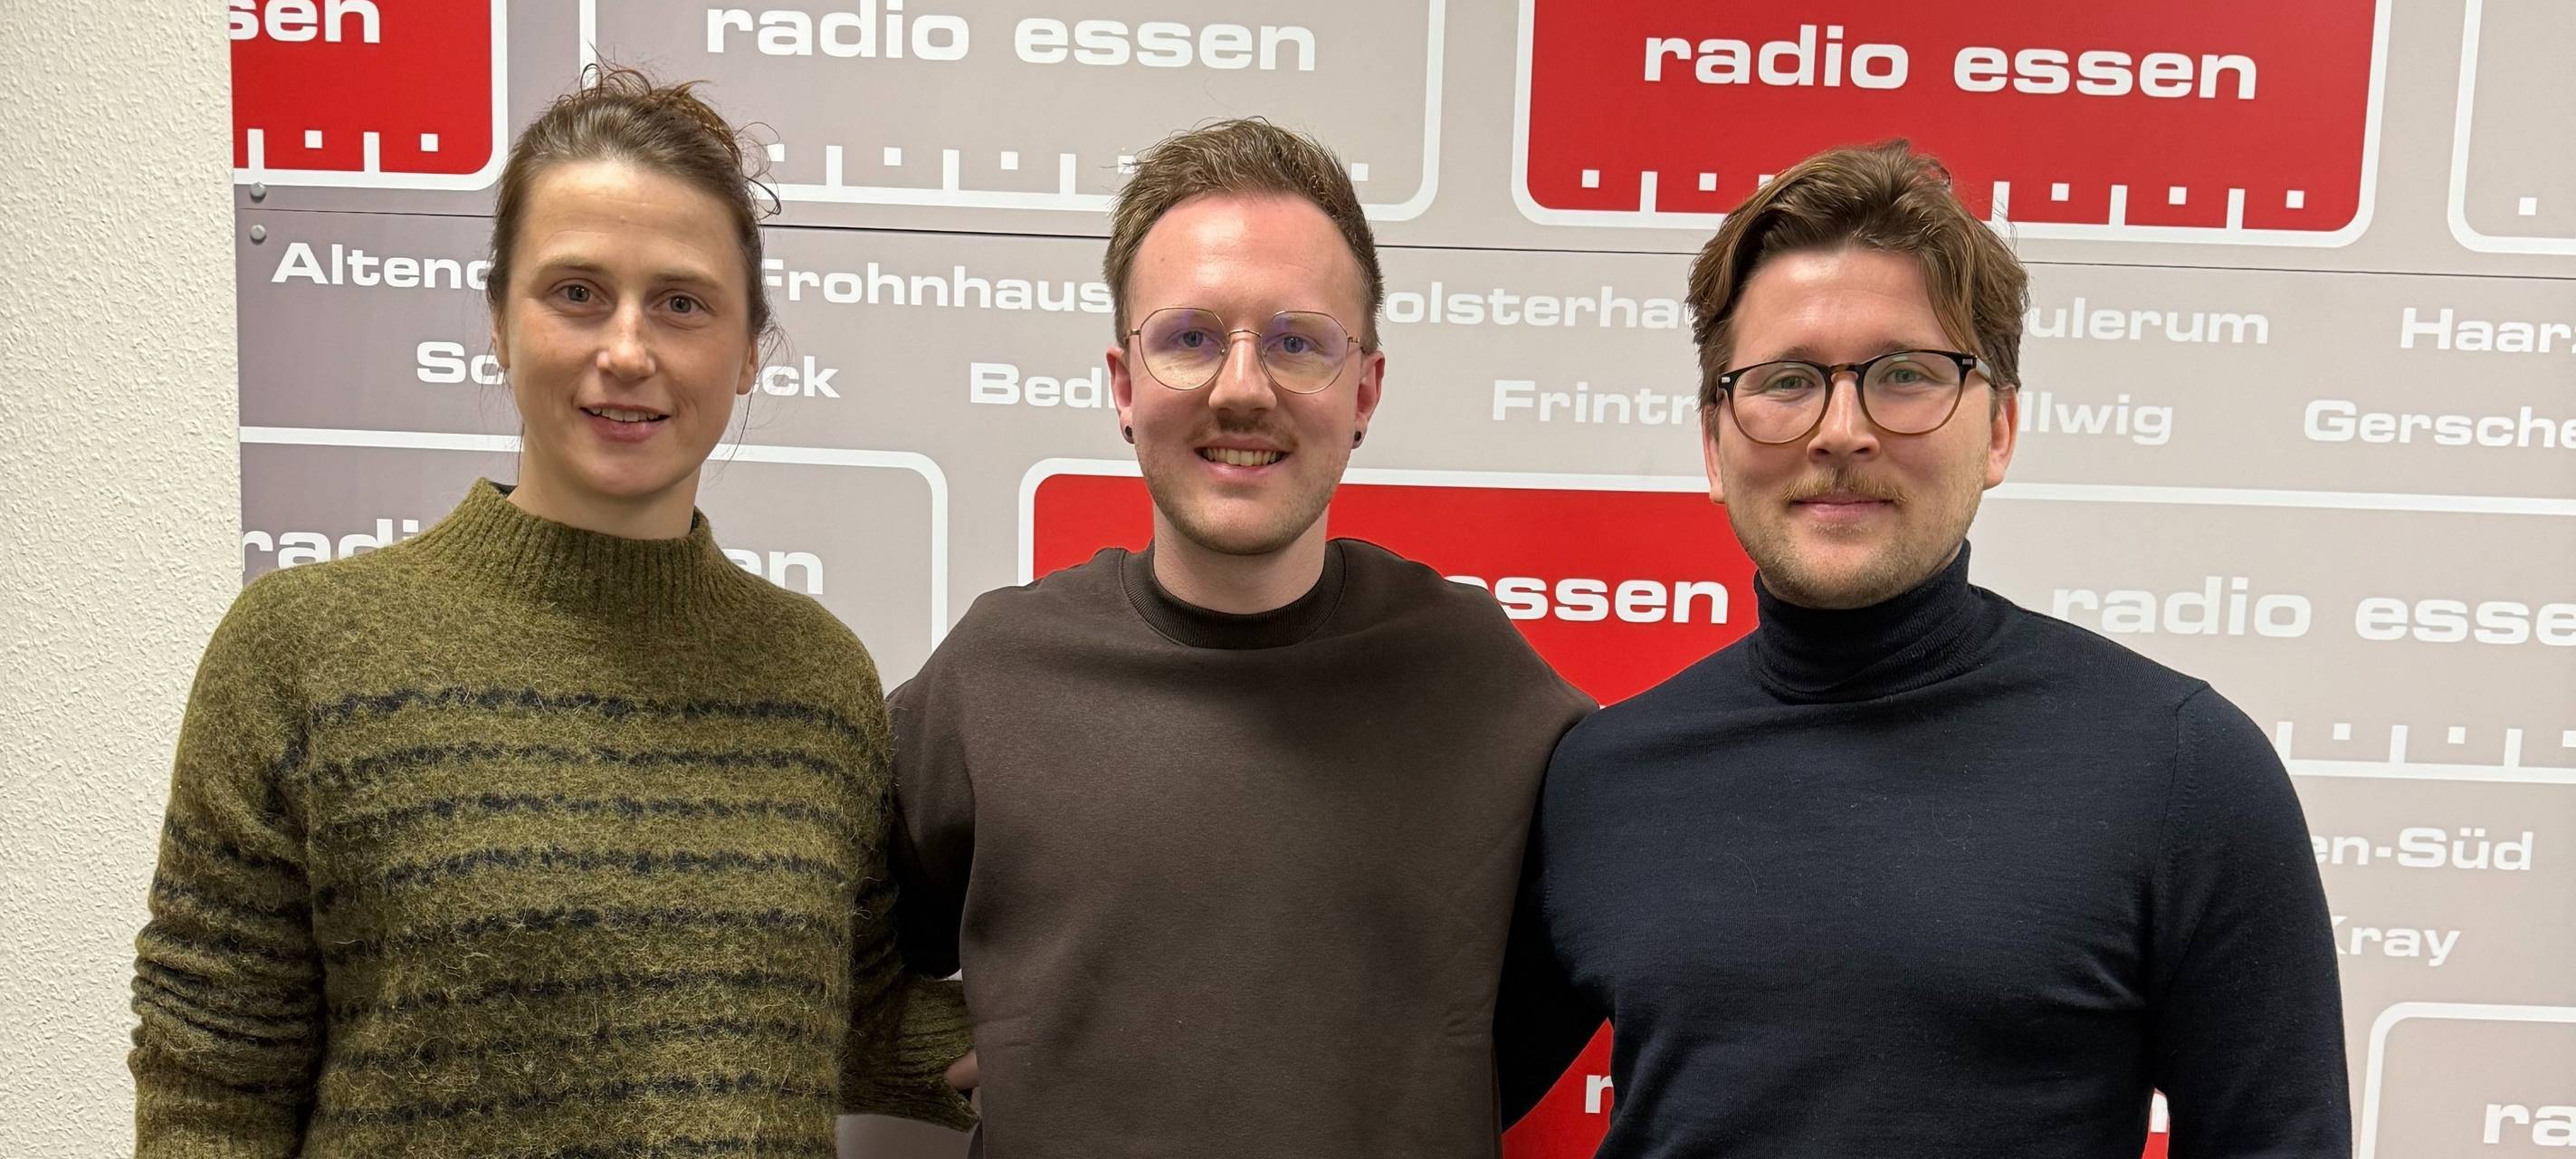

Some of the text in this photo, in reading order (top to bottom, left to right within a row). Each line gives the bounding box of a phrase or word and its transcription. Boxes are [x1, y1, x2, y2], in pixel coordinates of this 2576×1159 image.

[706, 0, 1315, 72] radio essen
[1644, 24, 2257, 100] radio essen
[1385, 282, 1698, 330] olsterha
[2028, 298, 2270, 344] ulerum
[2399, 307, 2576, 354] Haar
[1445, 575, 1729, 624] ssen
[2053, 576, 2312, 637] radio
